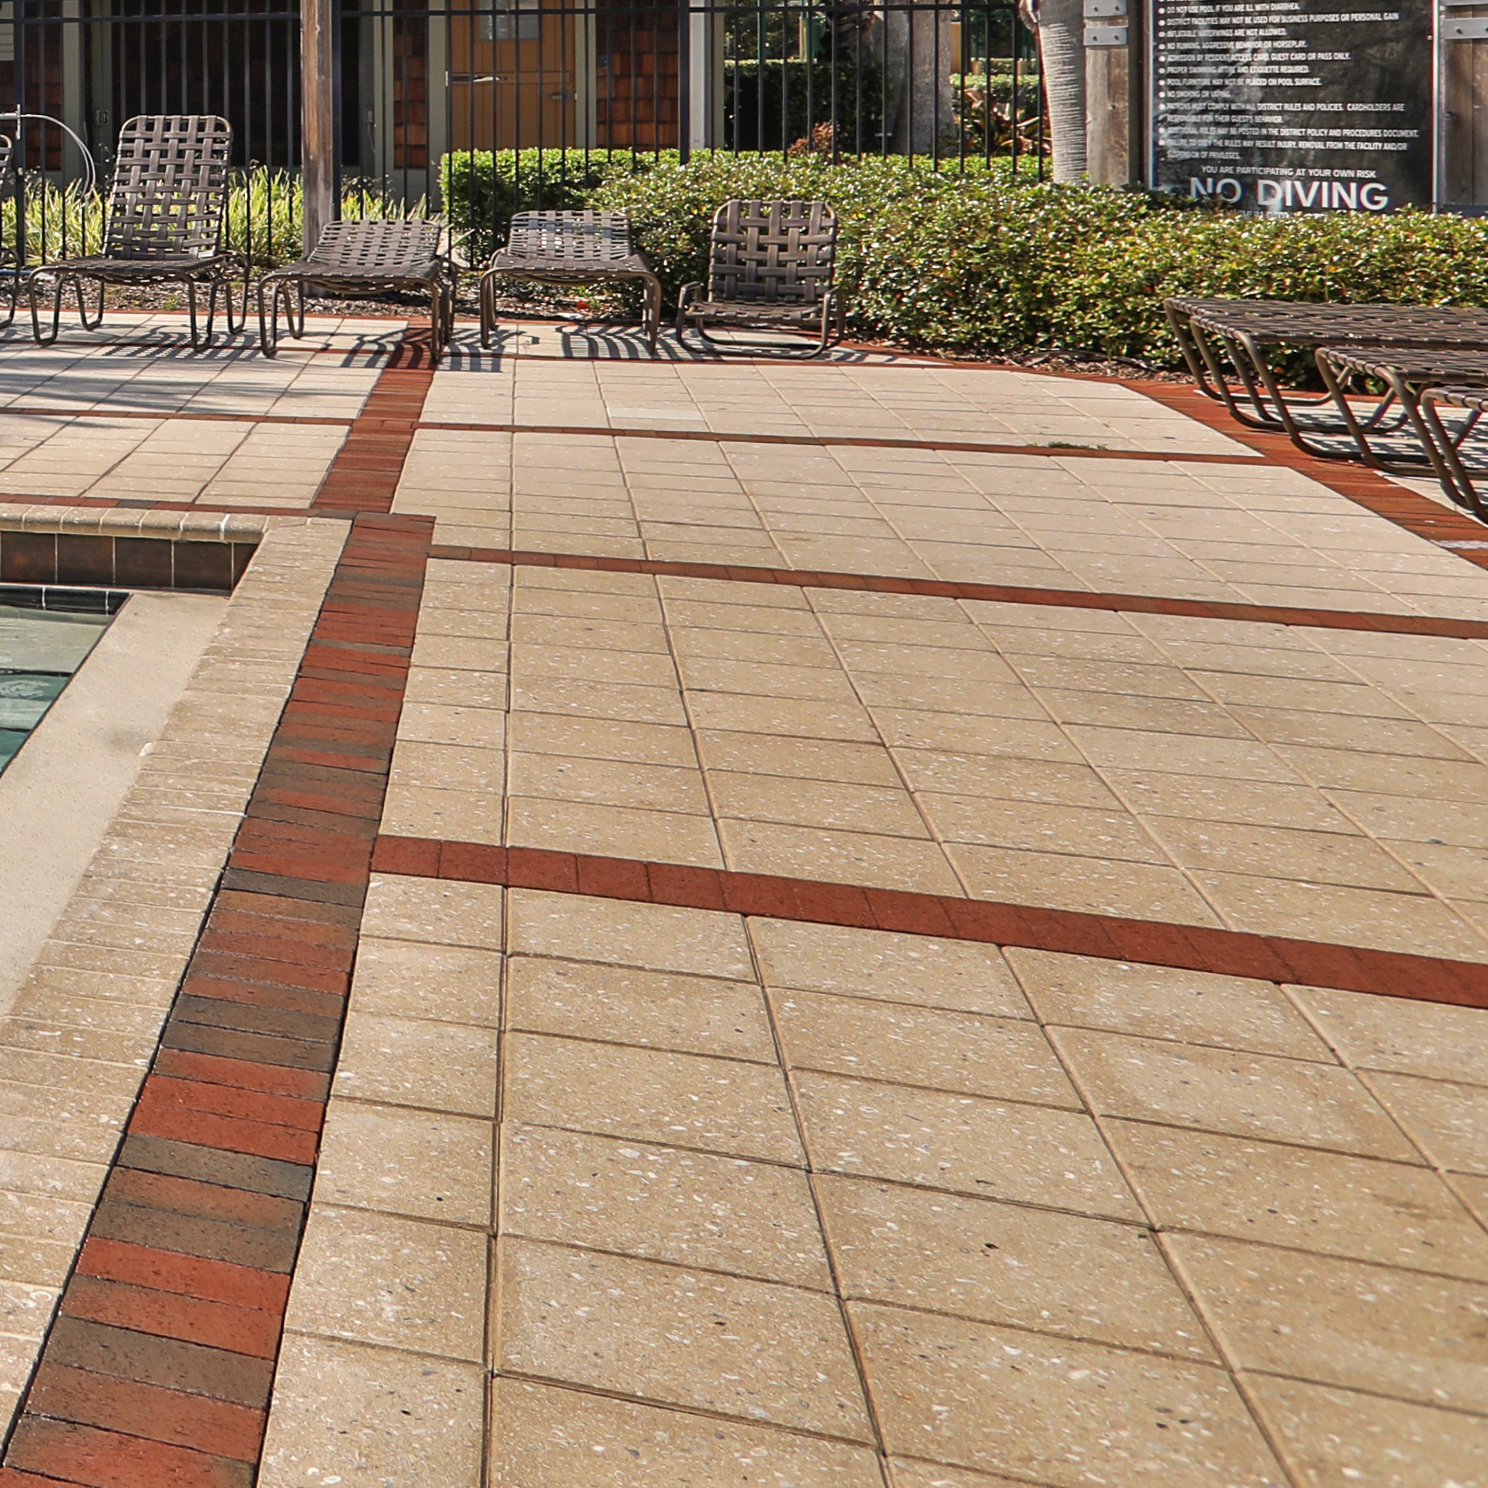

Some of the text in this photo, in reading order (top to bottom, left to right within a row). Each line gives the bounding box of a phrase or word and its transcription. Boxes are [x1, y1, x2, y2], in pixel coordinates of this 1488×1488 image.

[1281, 14, 1308, 23] BUSINESS
[1309, 13, 1339, 22] PURPOSES
[1350, 12, 1382, 21] PERSONAL
[1230, 53, 1251, 61] ACCESS
[1270, 52, 1289, 60] GUEST
[1333, 51, 1351, 59] ONLY.
[1294, 77, 1322, 85] SURFACE.
[1257, 102, 1282, 110] DISTRICT
[1280, 128, 1305, 136] DISTRICT
[1307, 128, 1327, 136] POLICY
[1342, 128, 1382, 137] PROCEDURES
[1383, 129, 1418, 137] DOCUMENT.
[1255, 140, 1275, 148] RESULT
[1298, 141, 1324, 149] REMOVAL
[1356, 142, 1381, 150] FACILITY
[1383, 142, 1407, 150] AND/OR
[1236, 166, 1293, 175] PARTICIPATING
[1308, 168, 1331, 176] YOUR
[1332, 169, 1355, 177] OWN
[1356, 169, 1376, 177] RISK
[1189, 176, 1389, 210] NO DIVING
